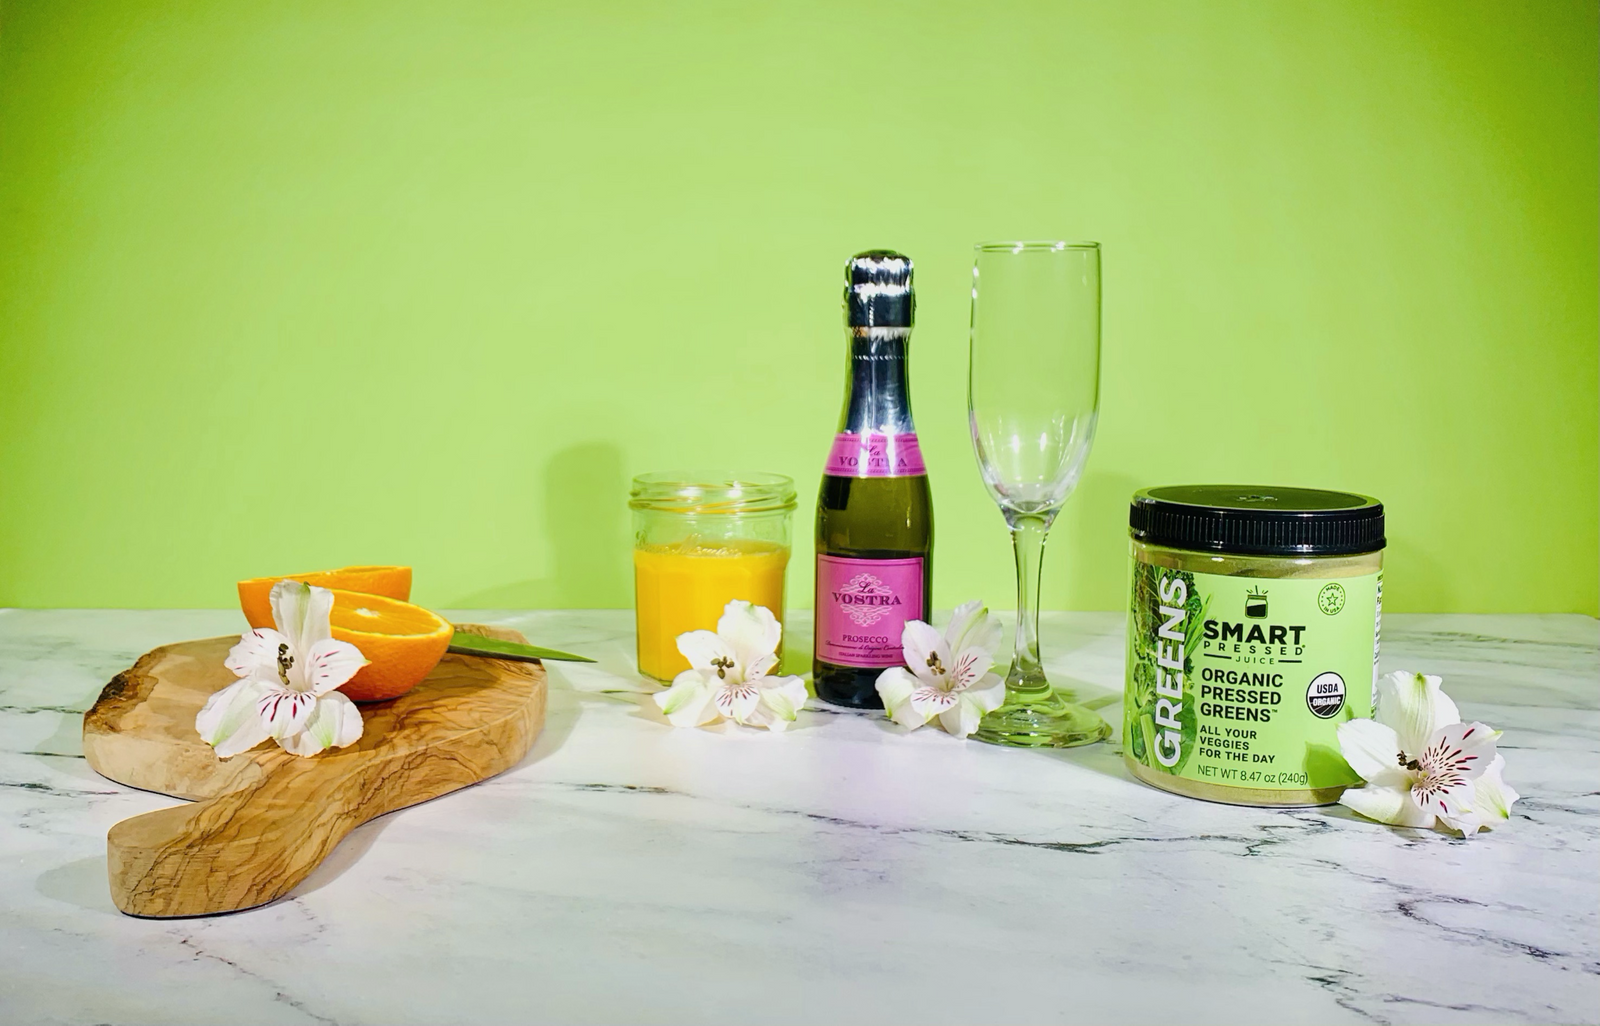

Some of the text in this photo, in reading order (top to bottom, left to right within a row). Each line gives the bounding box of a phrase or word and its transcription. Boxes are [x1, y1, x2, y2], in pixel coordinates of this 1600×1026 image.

[839, 456, 907, 467] VOTA
[858, 581, 875, 594] La
[832, 592, 902, 606] VOSTRA
[842, 634, 889, 644] PROSECCO
[1203, 619, 1306, 646] SMART
[1203, 640, 1303, 656] PRESSED
[1235, 655, 1275, 665] JUICE
[1154, 576, 1187, 768] GREENS
[1201, 667, 1284, 688] ORGANIC
[1200, 684, 1282, 706] PRESSED
[1316, 683, 1339, 694] USDA
[1312, 696, 1341, 707] ORGANIC
[1199, 724, 1257, 740] ALL YOUR
[1199, 735, 1250, 751] VEGGIES
[1199, 747, 1276, 764] FOR THE DAY
[1197, 764, 1308, 786] NET WT 8.47 oz (240g)
